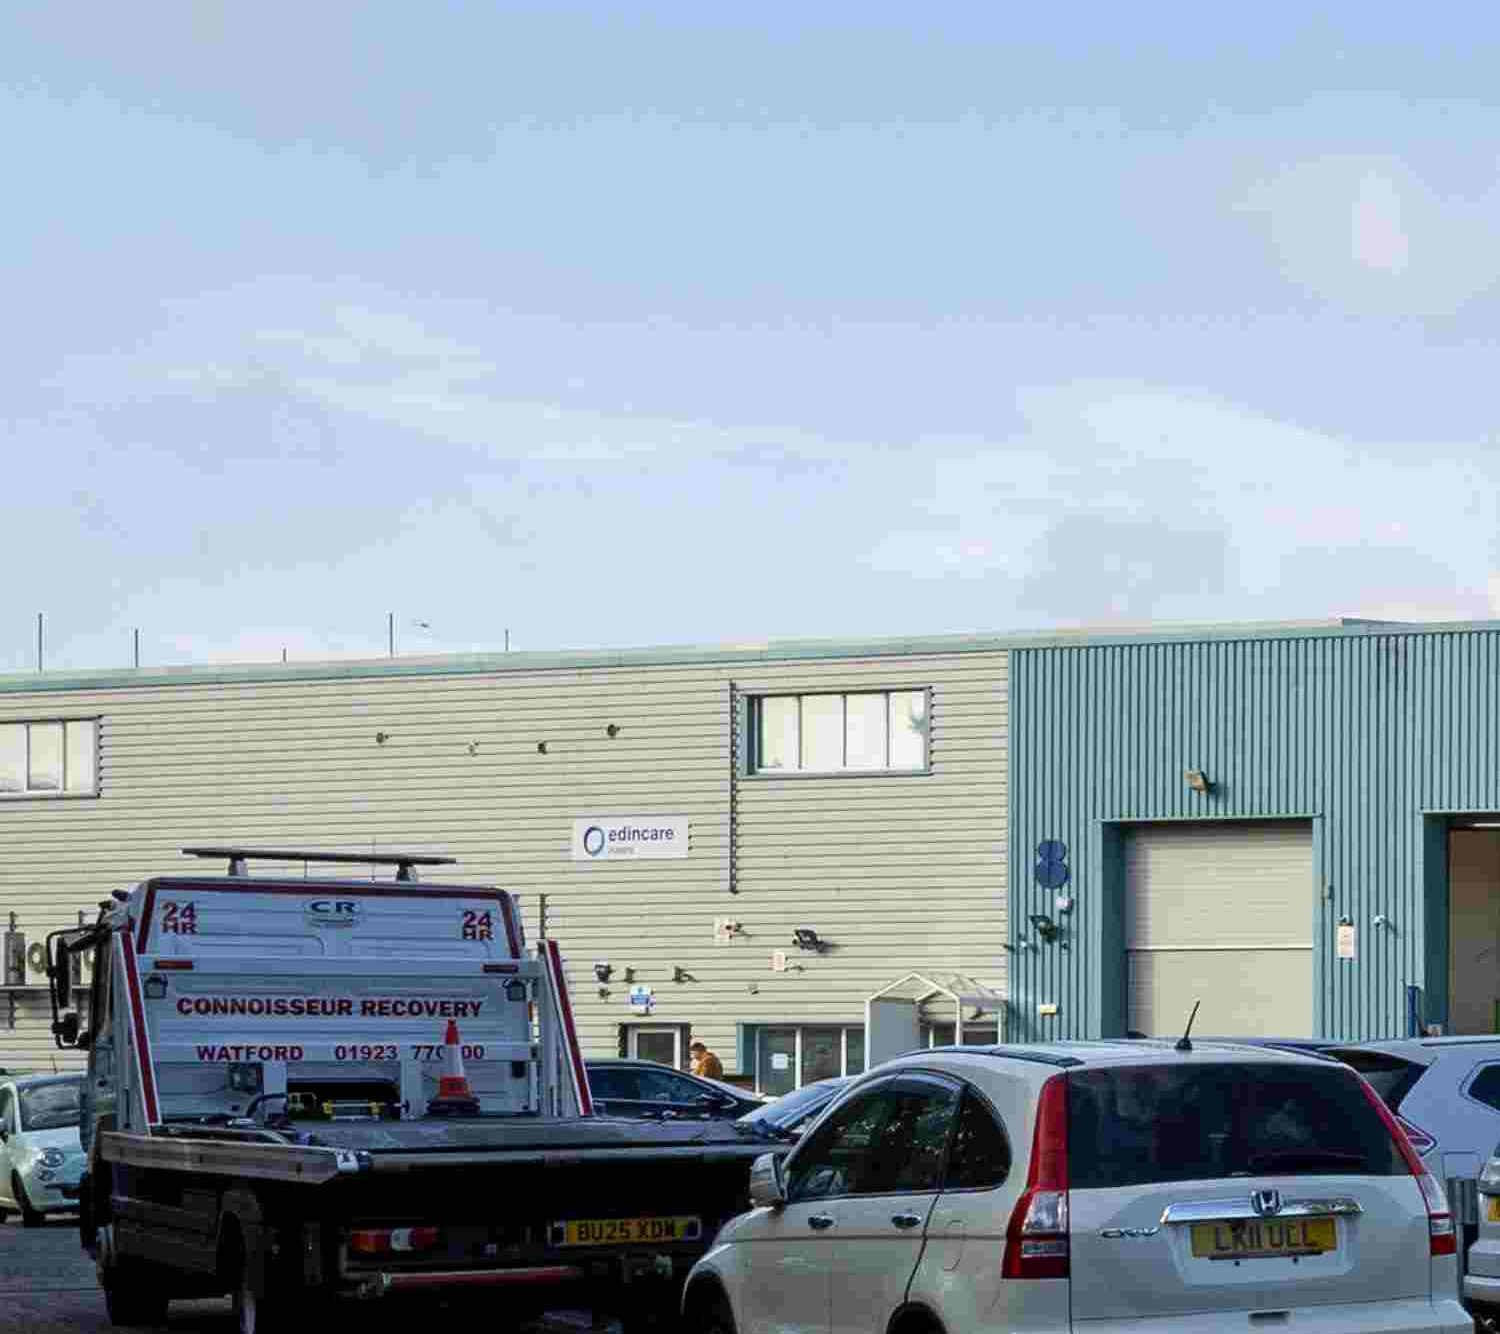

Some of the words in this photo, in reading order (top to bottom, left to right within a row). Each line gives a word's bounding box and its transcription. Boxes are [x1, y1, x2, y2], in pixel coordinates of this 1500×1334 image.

[608, 826, 674, 842] edincare
[162, 901, 197, 922] 24
[310, 901, 357, 914] CR
[463, 910, 493, 927] 24
[162, 922, 197, 935] HR
[463, 926, 493, 940] HR
[176, 998, 353, 1016] CONNOISSEUR
[360, 1000, 483, 1018] RECOVERY
[196, 1045, 304, 1061] WATFORD
[335, 1045, 398, 1060] 01923
[411, 1045, 486, 1060] 77000
